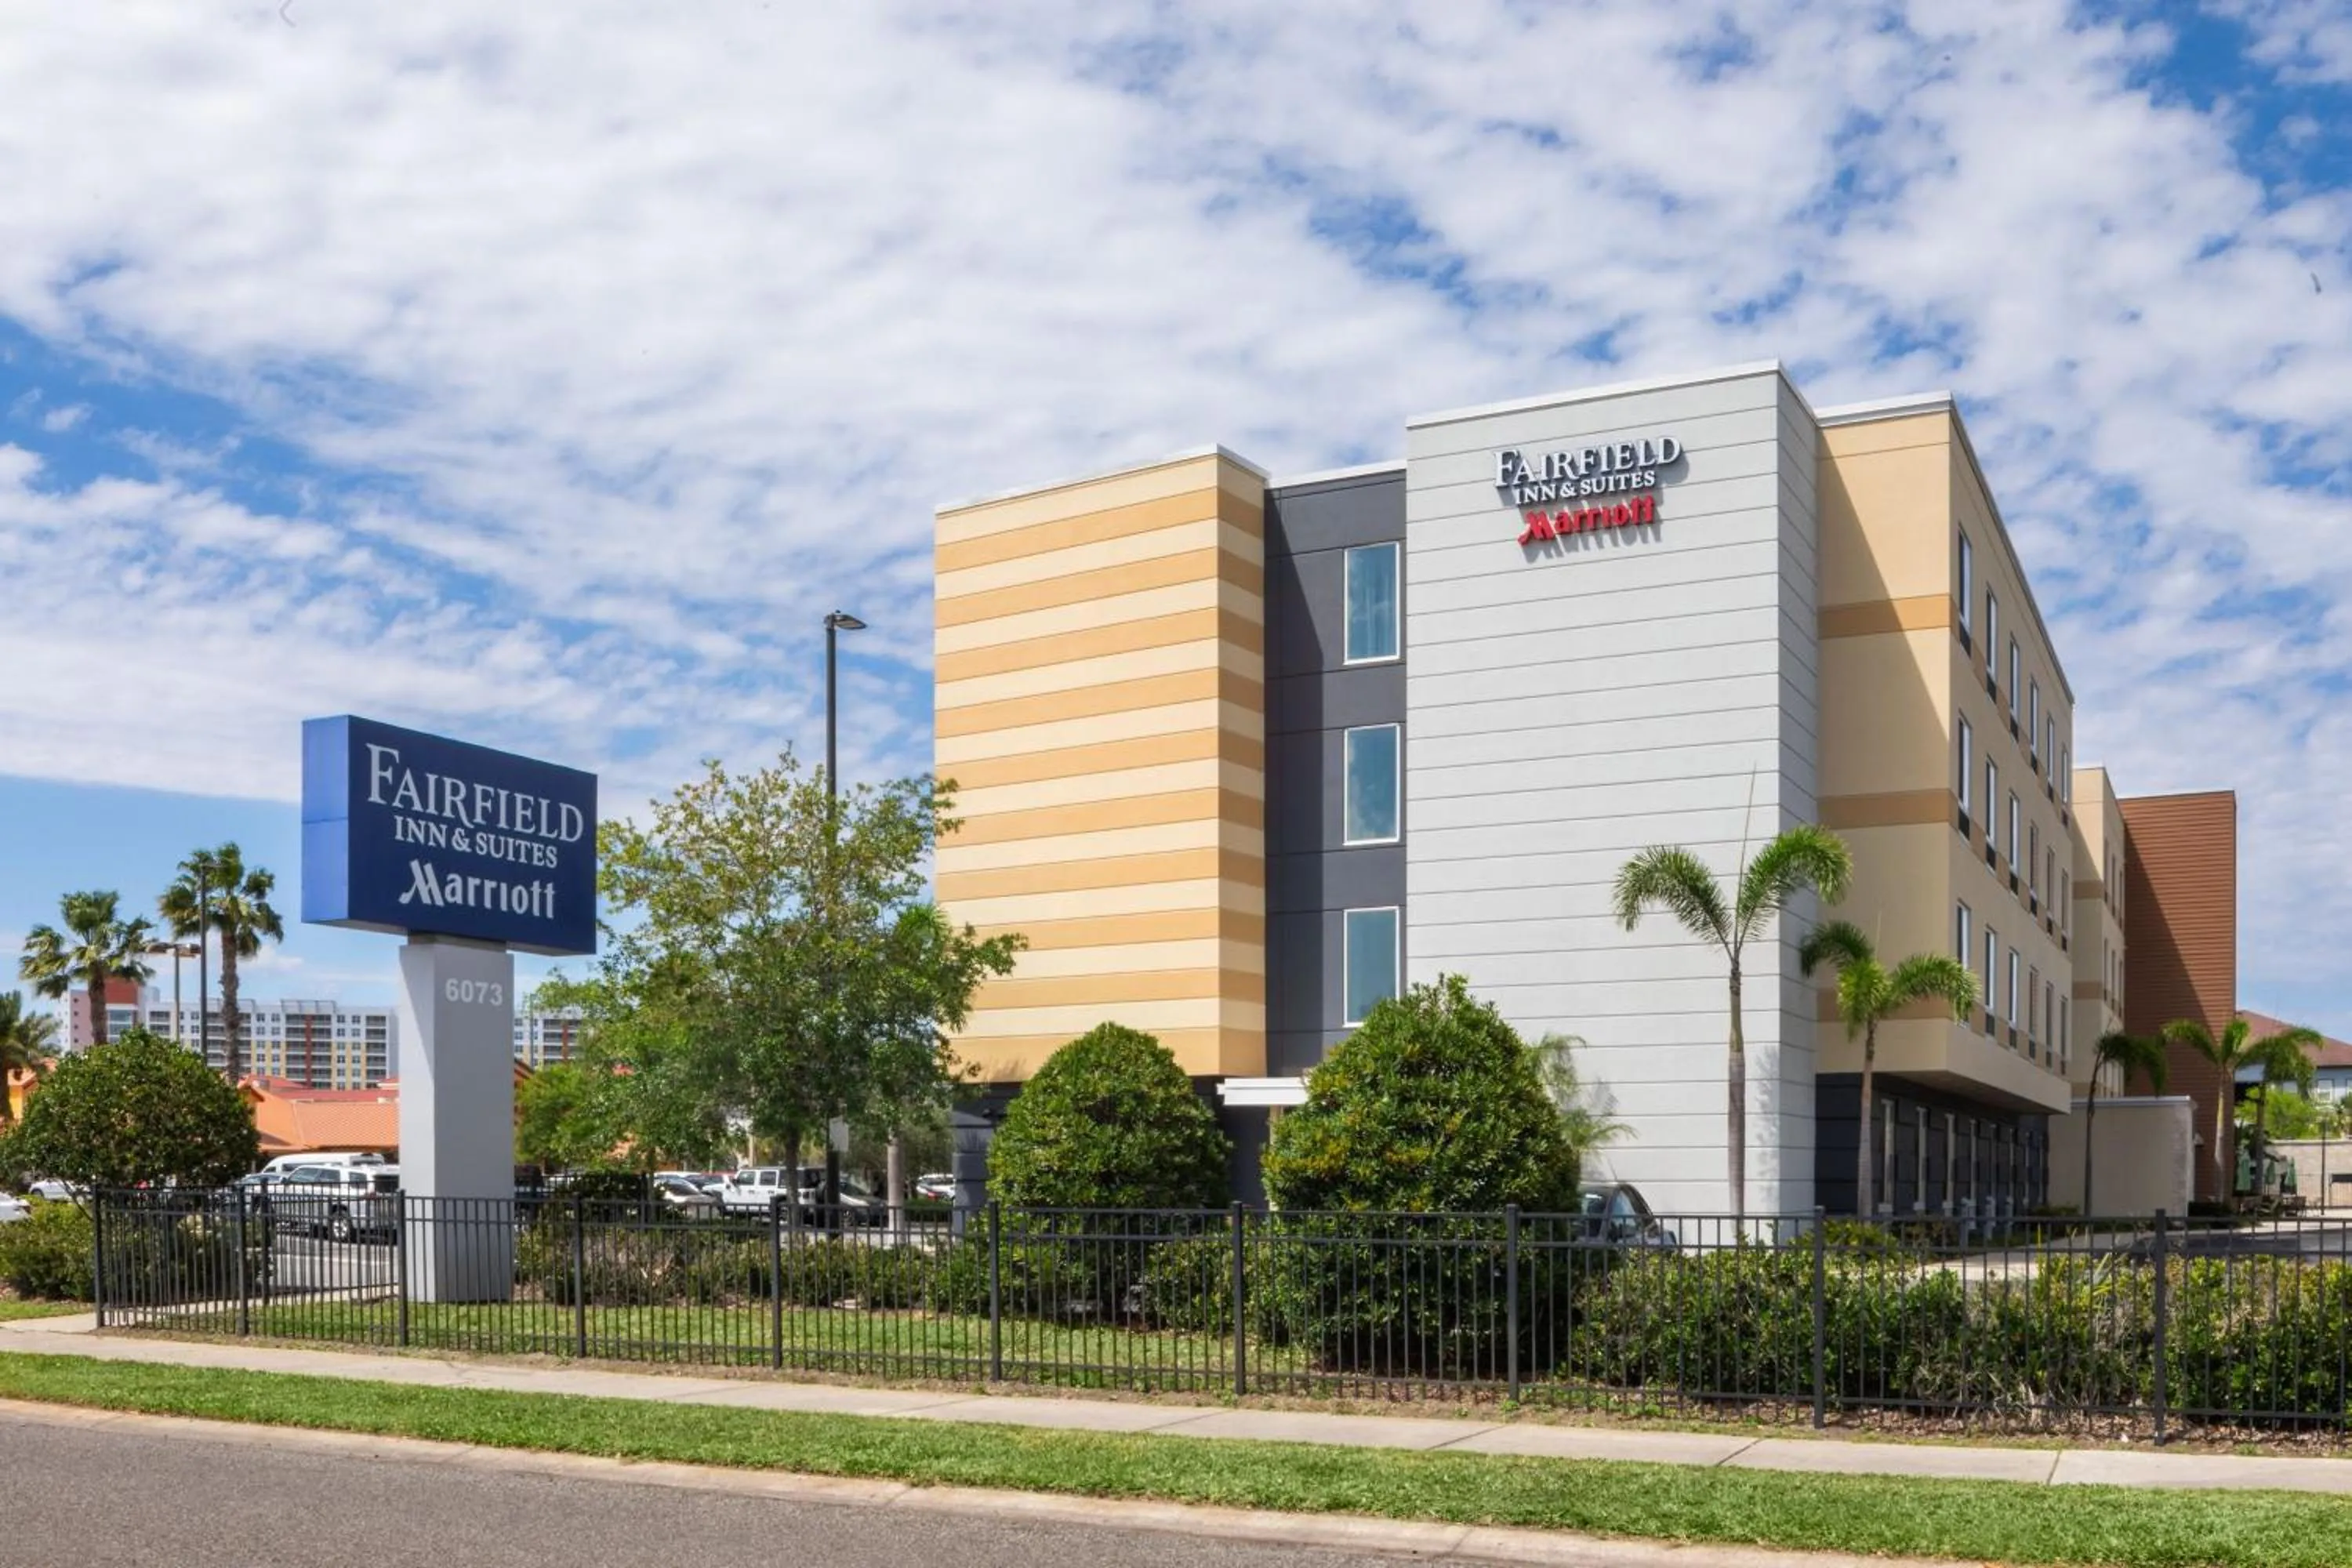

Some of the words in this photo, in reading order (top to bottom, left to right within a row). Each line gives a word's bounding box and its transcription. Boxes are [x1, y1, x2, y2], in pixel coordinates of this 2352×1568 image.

[1495, 437, 1682, 488] FAIRFIELD
[1515, 483, 1557, 504] INN
[1559, 482, 1576, 497] &
[1580, 470, 1656, 495] SUITES
[1518, 494, 1655, 546] Marriott
[365, 743, 583, 842] FAIRFIELD
[394, 815, 446, 848] INN
[452, 828, 471, 852] &
[476, 833, 557, 869] SUITES
[398, 859, 555, 918] Marriott
[445, 978, 503, 1006] 6073
